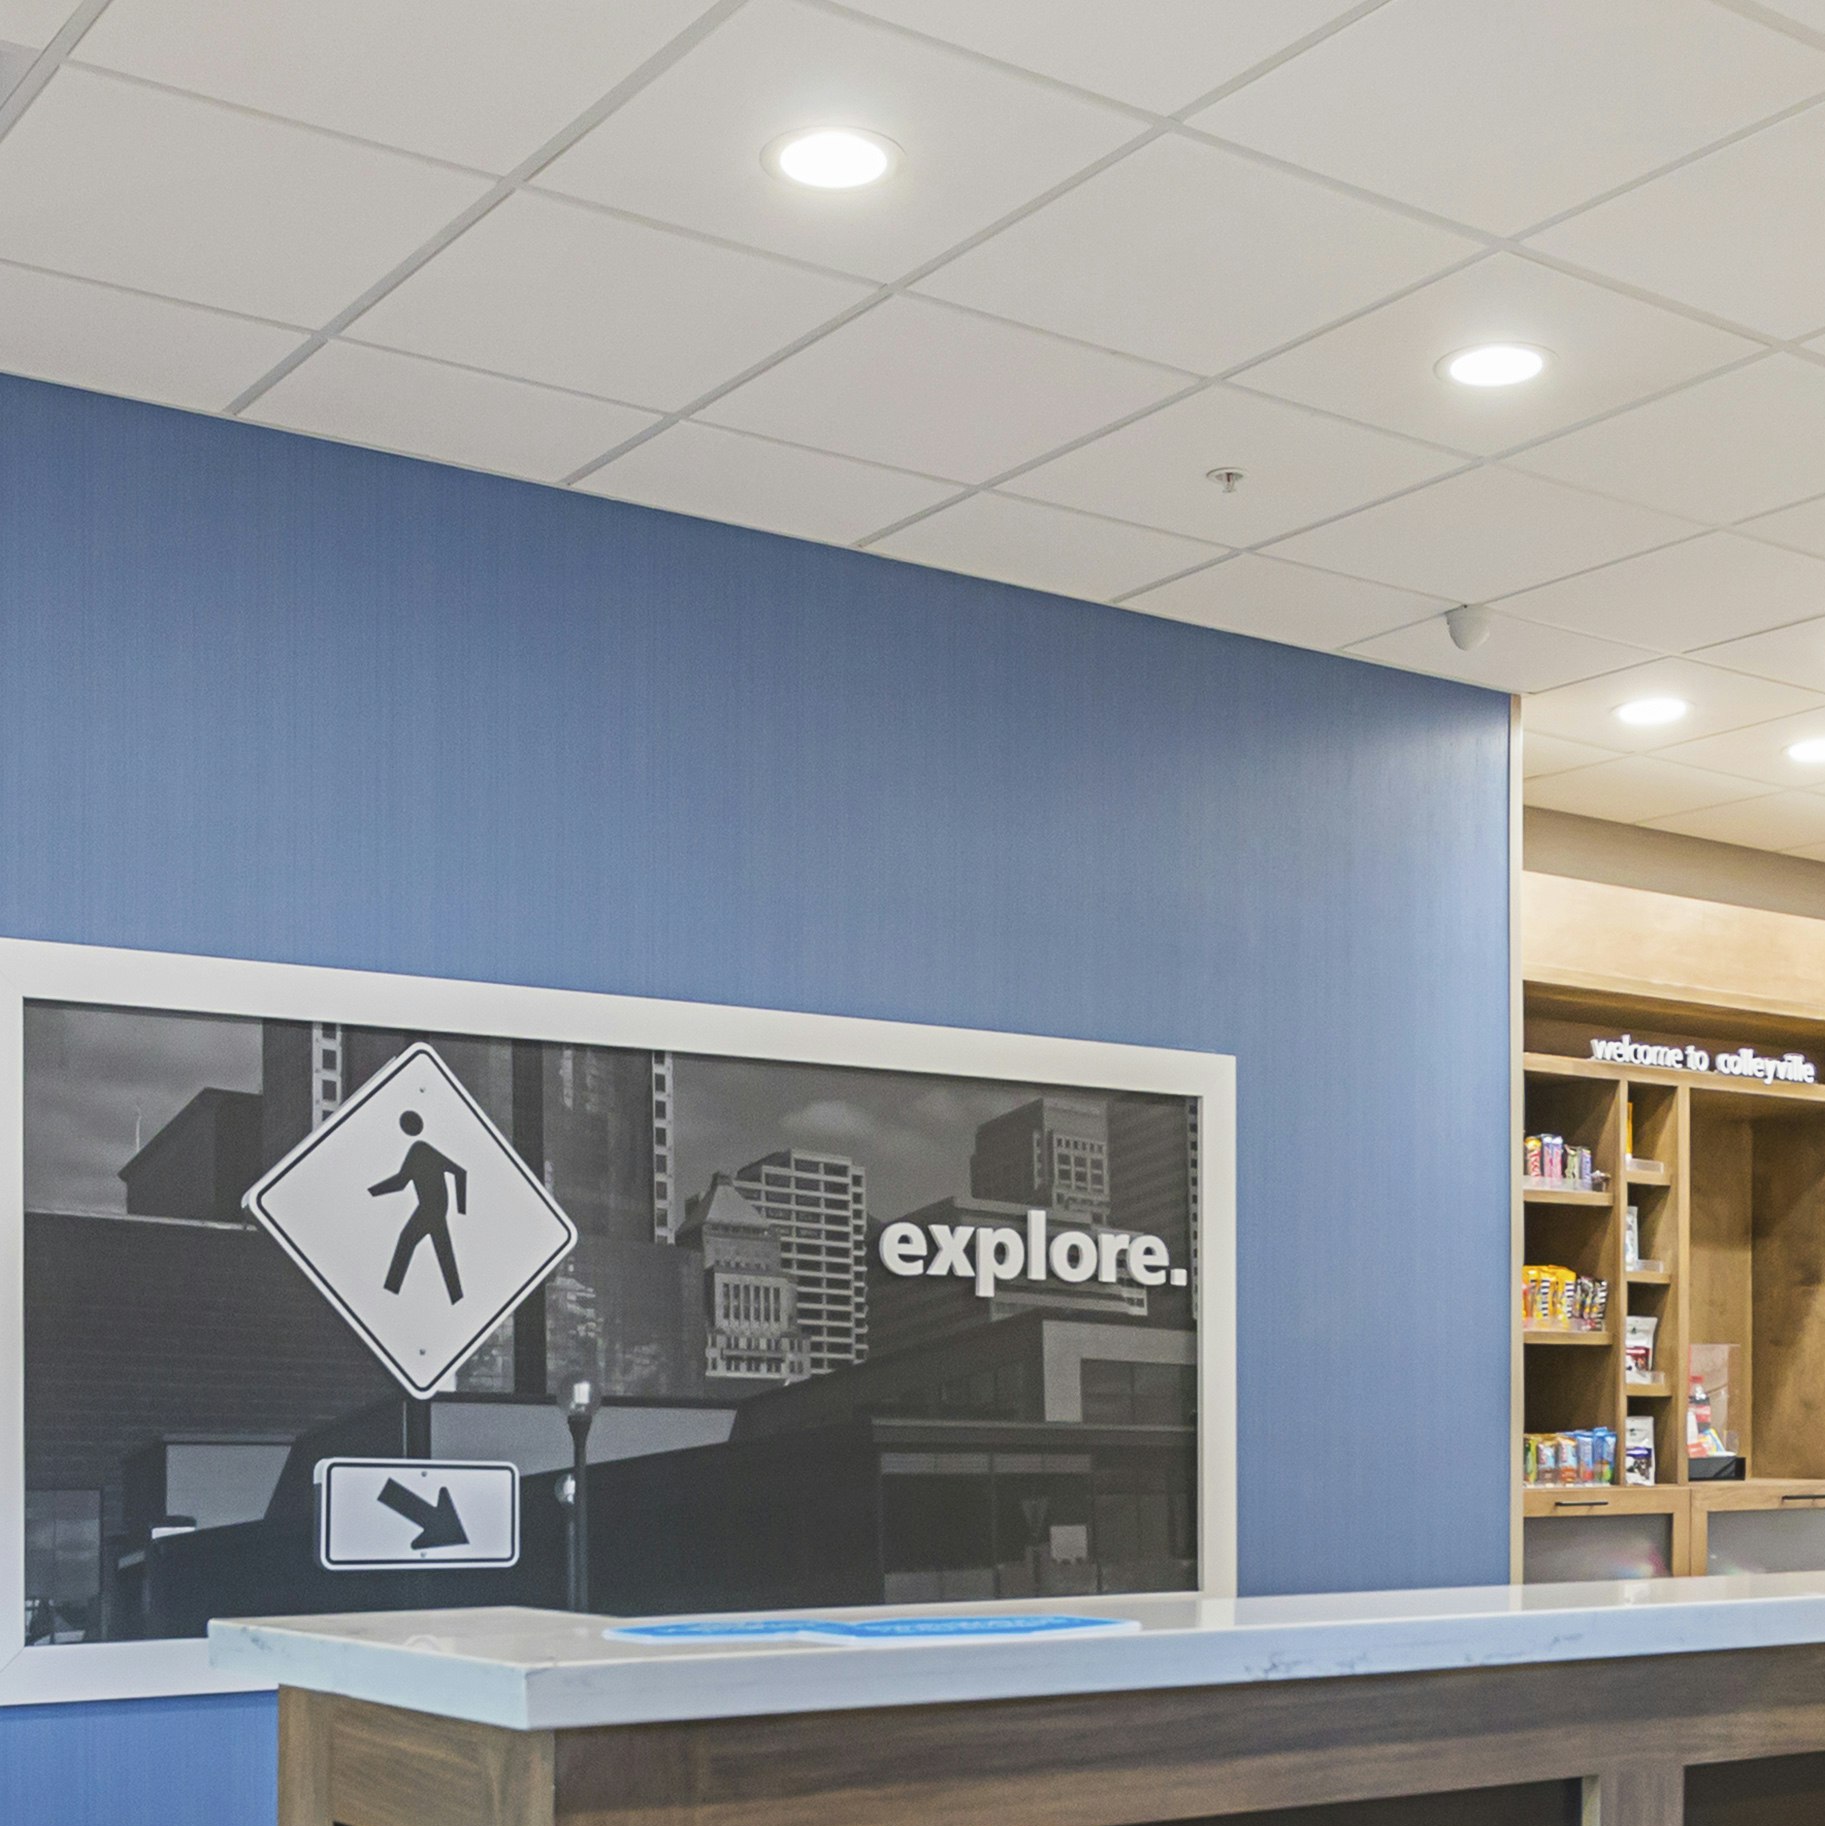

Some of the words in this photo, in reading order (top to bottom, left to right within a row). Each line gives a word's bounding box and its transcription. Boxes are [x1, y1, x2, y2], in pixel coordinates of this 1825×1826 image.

[1590, 1034, 1683, 1069] welcome
[1685, 1045, 1710, 1071] to
[1715, 1048, 1815, 1084] colleyville
[879, 1210, 1187, 1297] explore.
